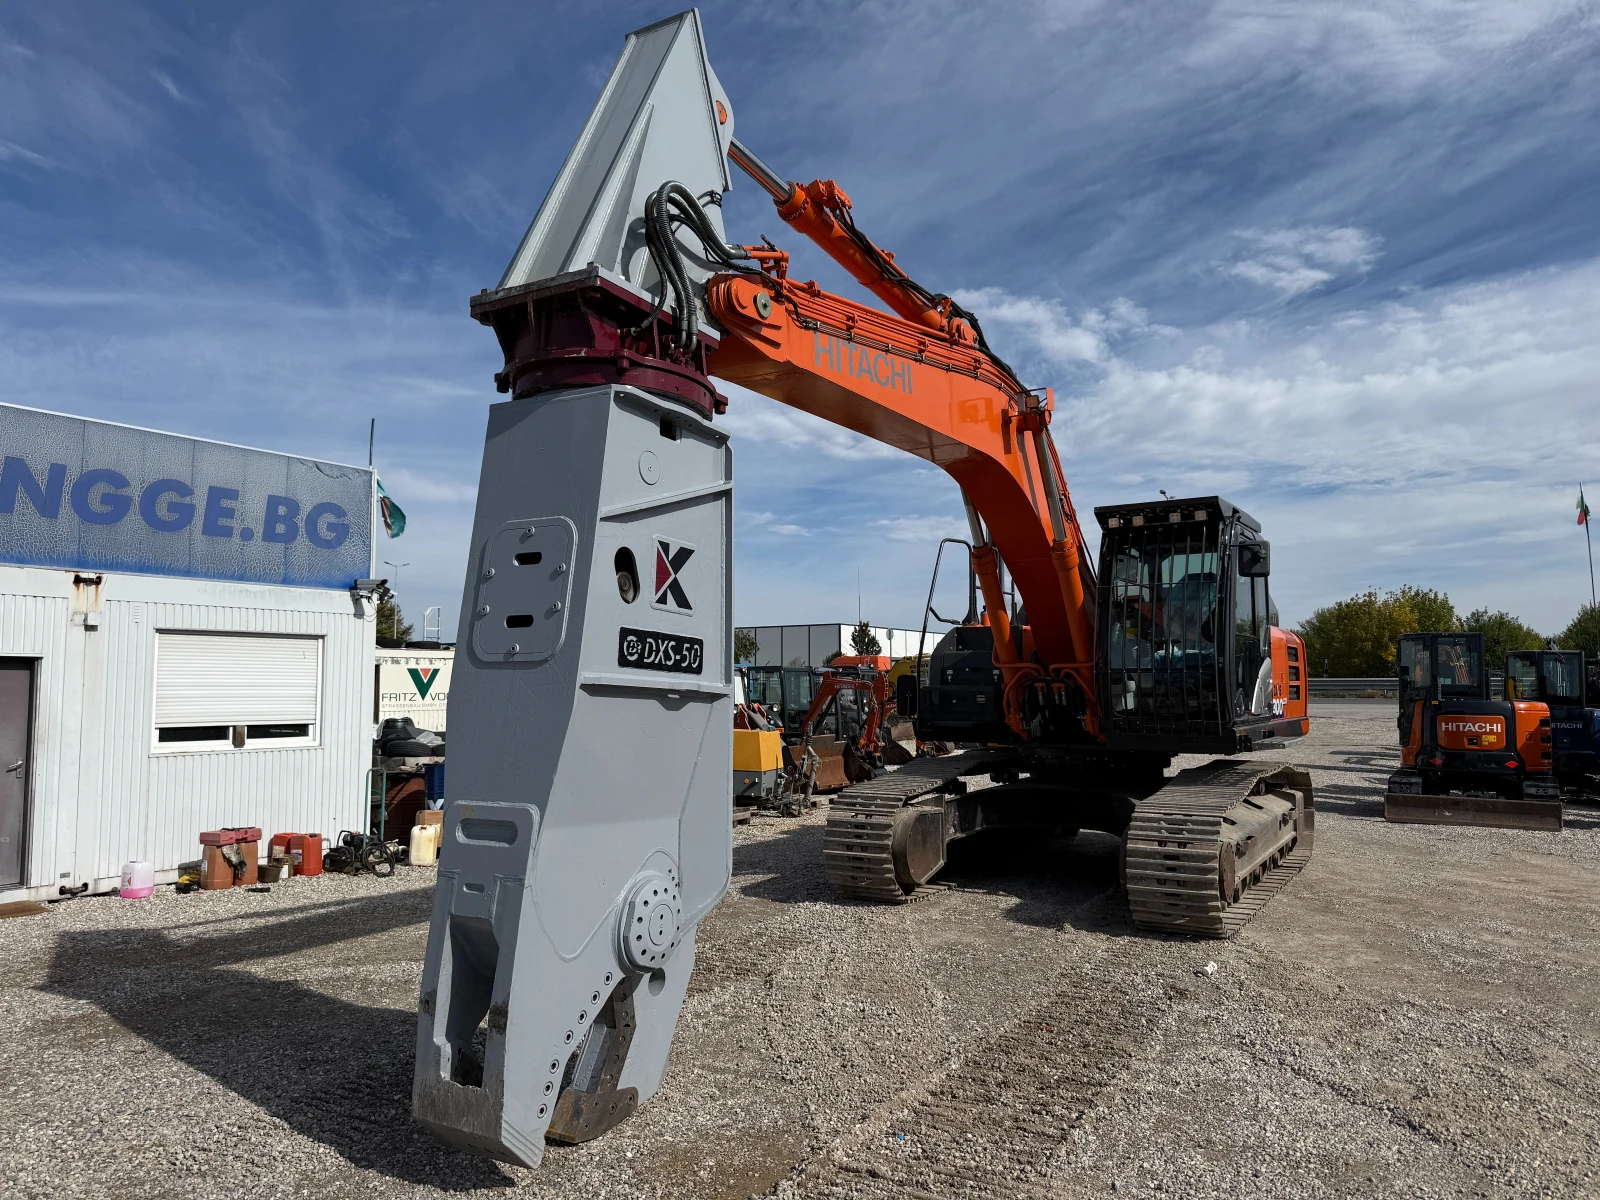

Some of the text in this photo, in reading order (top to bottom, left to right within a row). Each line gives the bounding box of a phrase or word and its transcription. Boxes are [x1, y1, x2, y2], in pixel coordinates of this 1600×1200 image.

[814, 331, 913, 395] HITACHI
[643, 638, 701, 669] DXS-50
[381, 692, 449, 702] FRITZ VO
[1441, 722, 1502, 733] HITACHI
